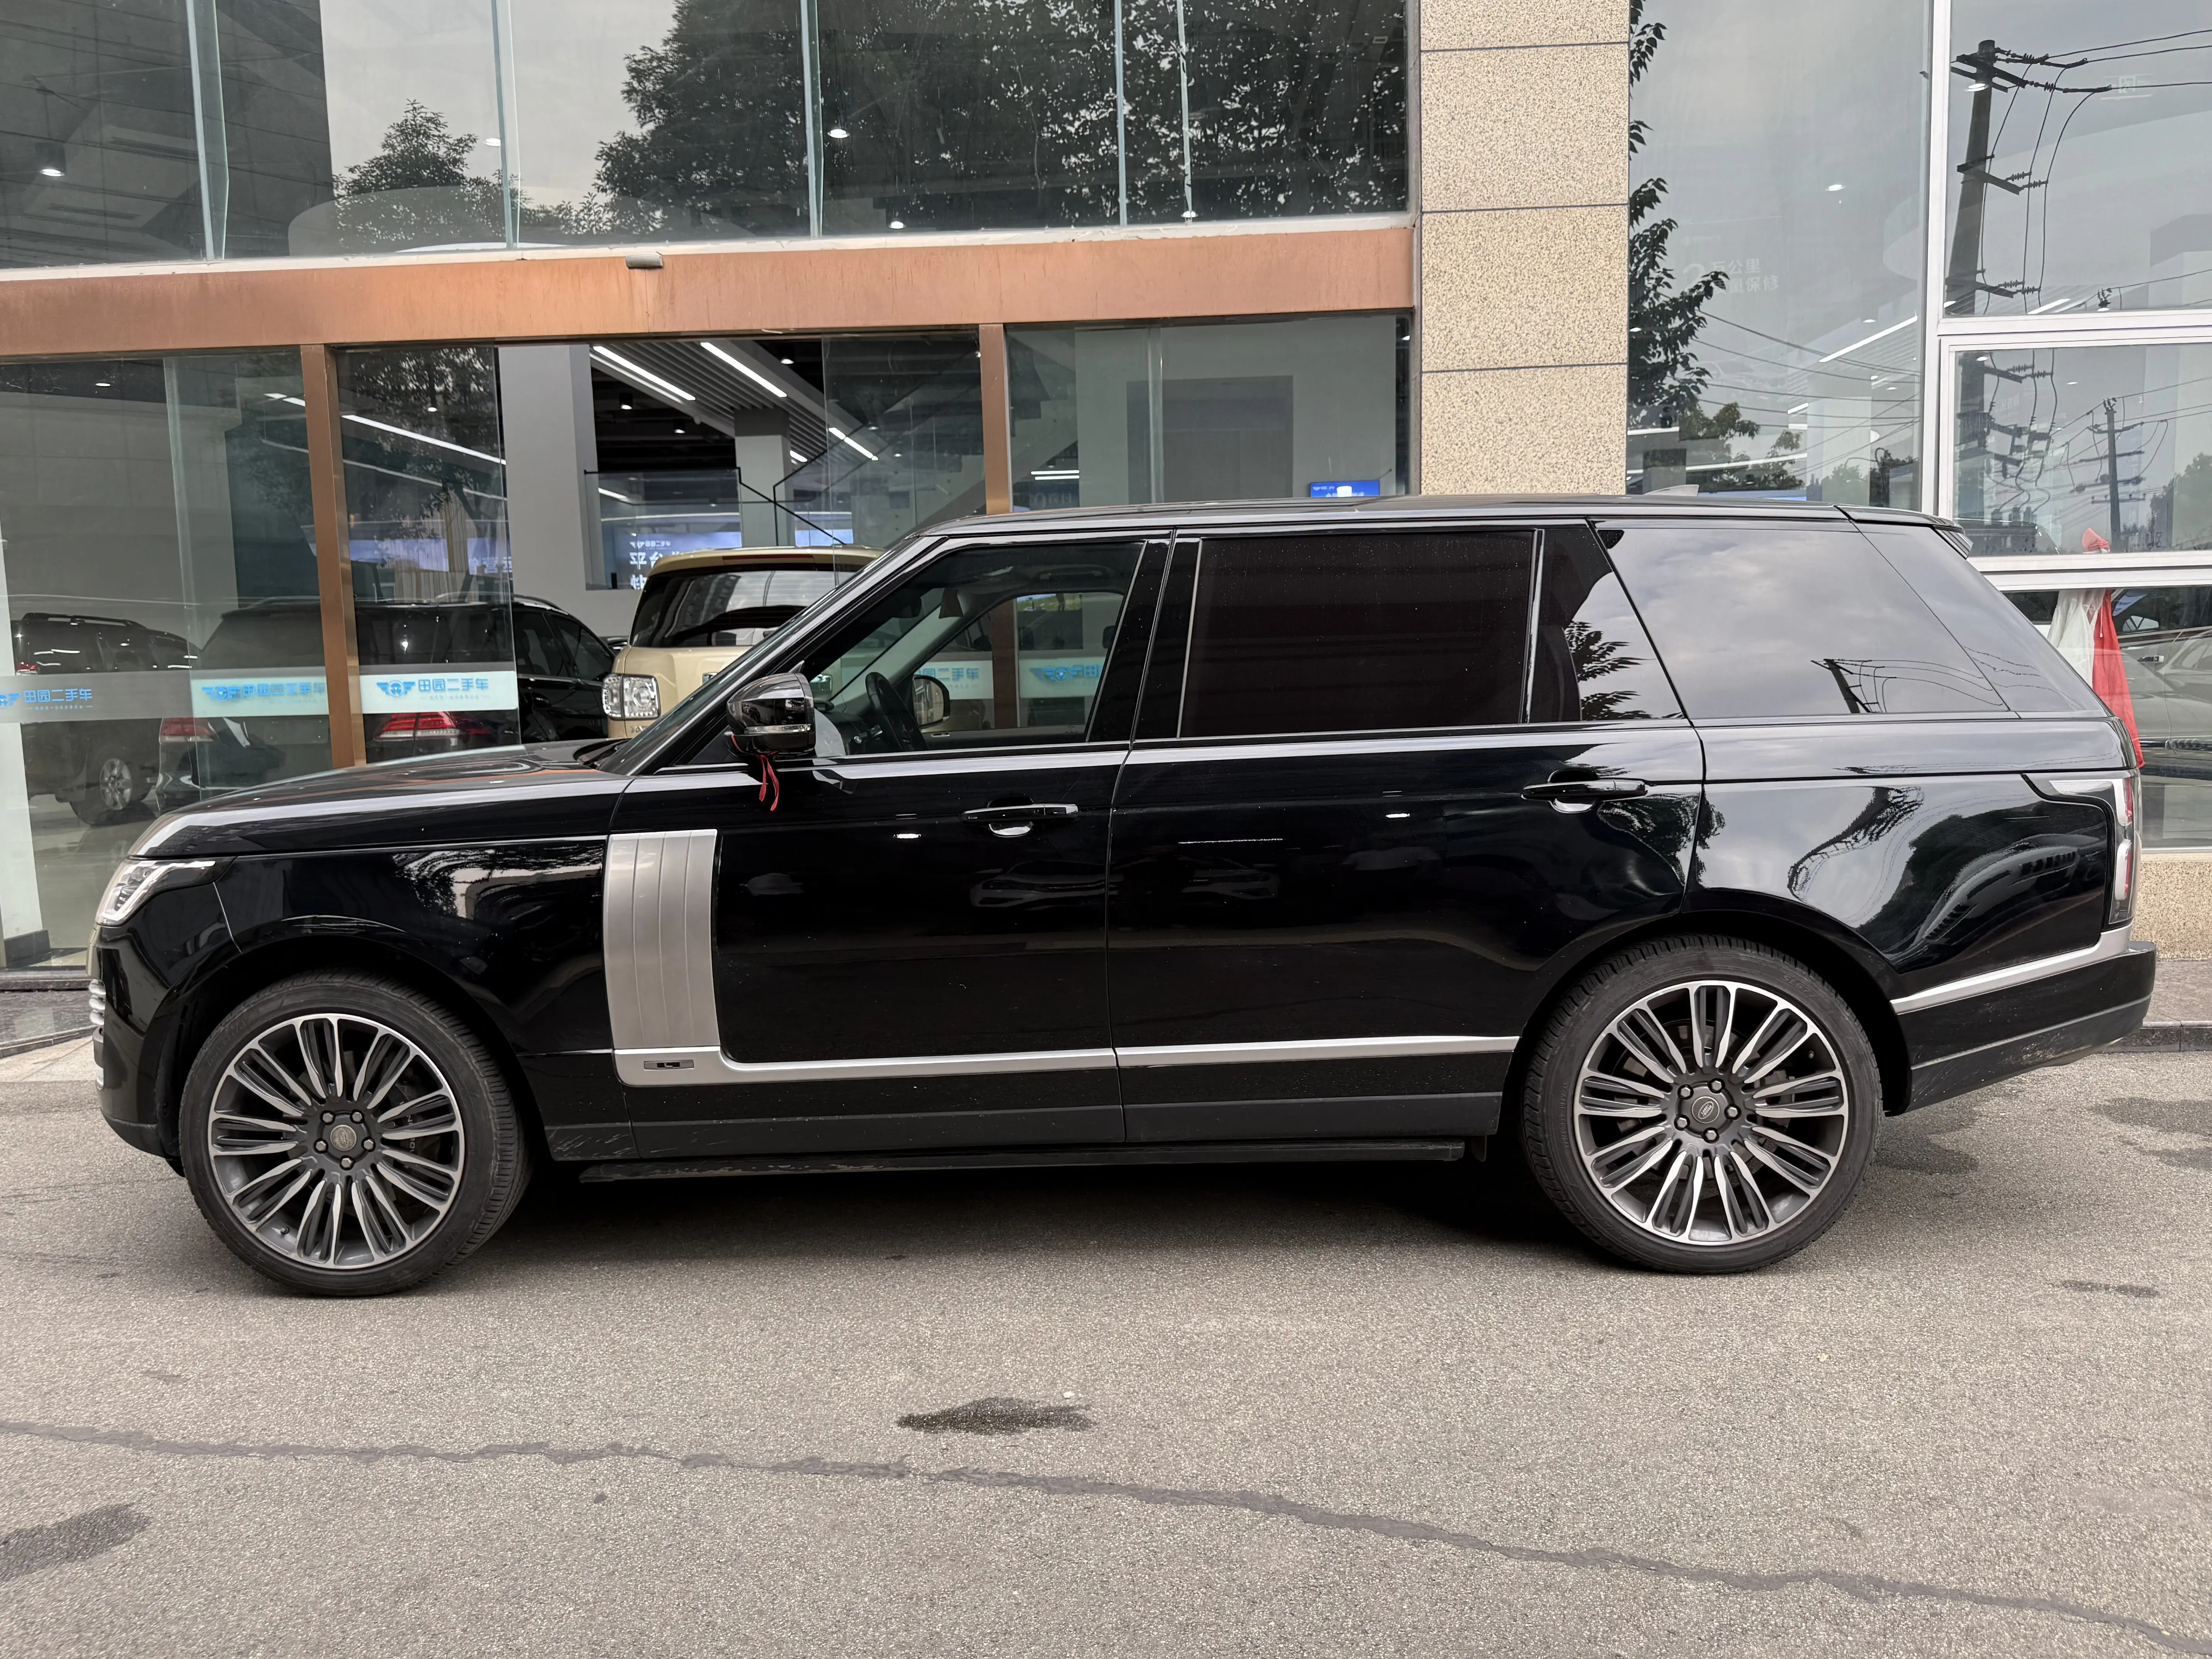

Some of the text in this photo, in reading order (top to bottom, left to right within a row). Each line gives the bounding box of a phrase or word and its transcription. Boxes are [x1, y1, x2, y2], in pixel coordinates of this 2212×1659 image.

[1713, 275, 1779, 294] 量保修
[418, 678, 489, 692] 田园二手车
[24, 688, 93, 703] 田园二手车
